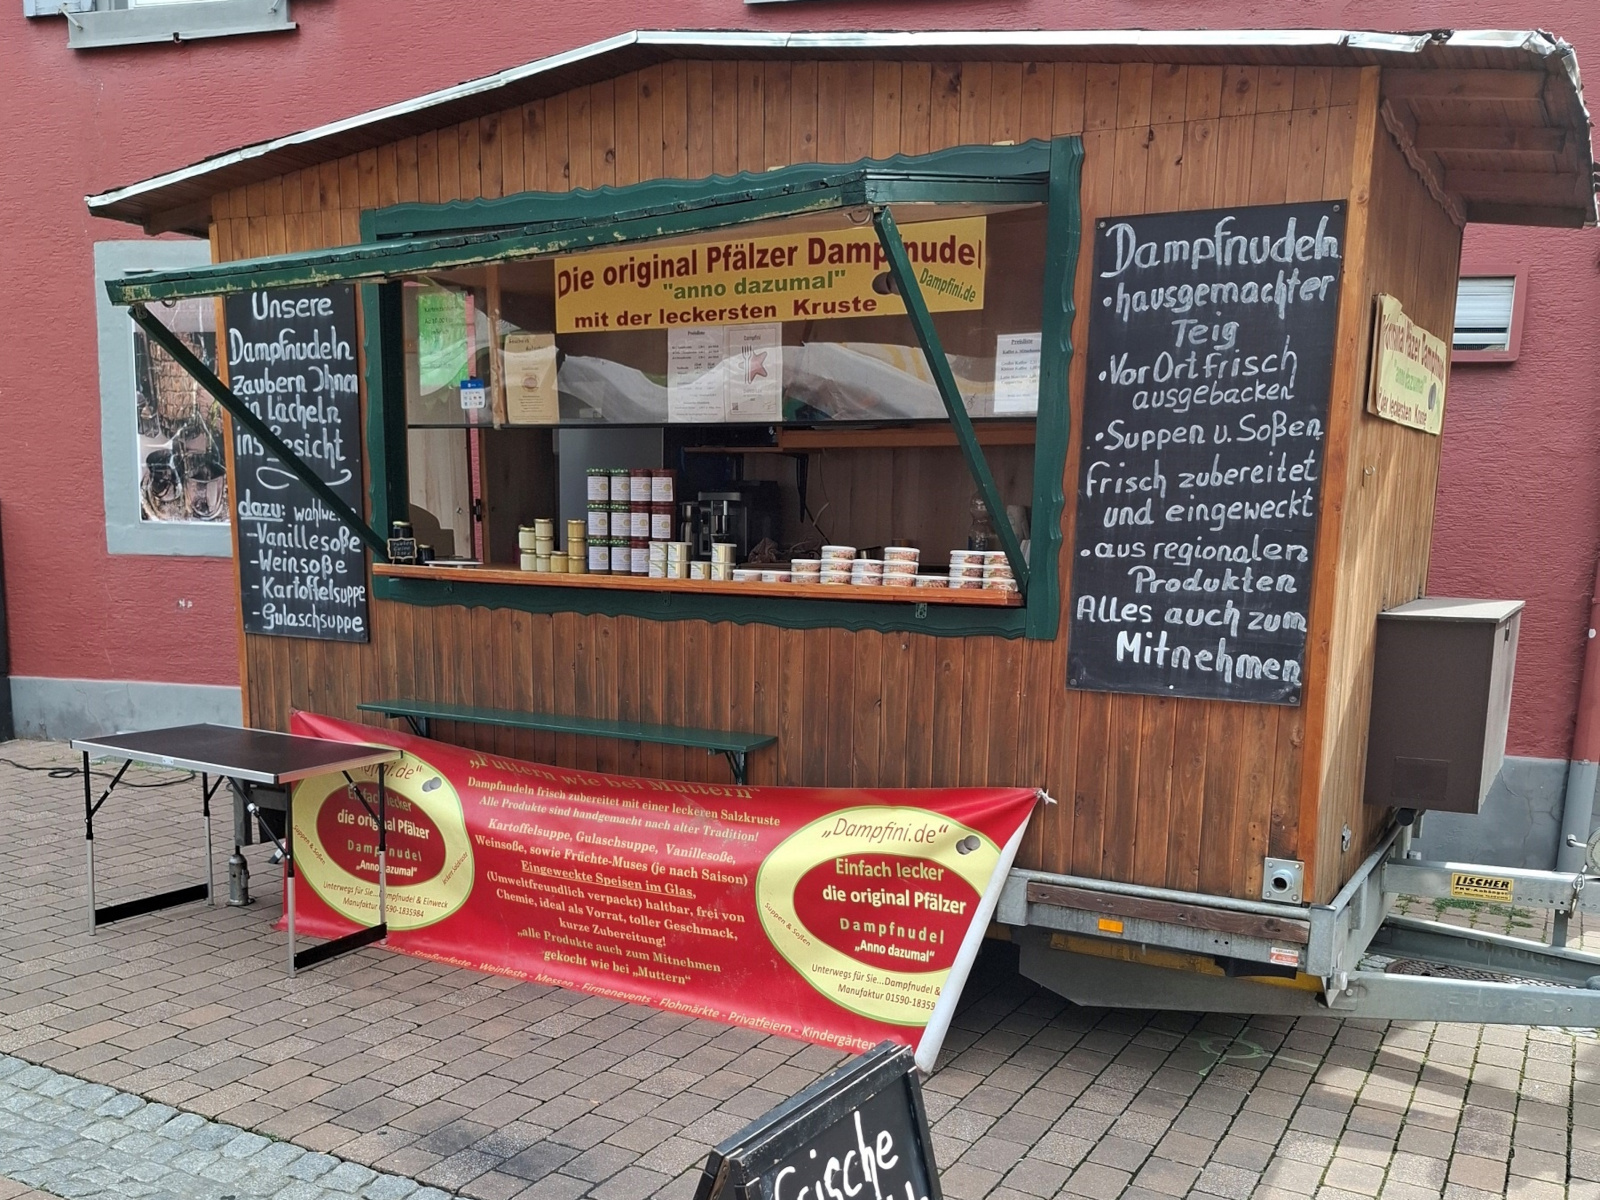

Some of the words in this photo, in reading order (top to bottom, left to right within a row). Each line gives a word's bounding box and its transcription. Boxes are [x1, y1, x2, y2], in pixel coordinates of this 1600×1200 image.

[1100, 215, 1342, 278] Dampfnudeln
[558, 266, 595, 299] Die
[603, 248, 698, 289] original
[707, 242, 799, 274] Pfälzer
[808, 234, 982, 271] Dampnudel
[919, 267, 976, 303] Dampfini.de
[1115, 268, 1336, 323] hausgemachter
[252, 291, 334, 320] Unsere
[575, 312, 609, 328] mit
[617, 310, 653, 326] der
[659, 303, 777, 325] leckersten
[793, 296, 877, 316] Kruste
[229, 325, 354, 366] Dampfnudeln
[1171, 311, 1240, 351] Teig
[1110, 352, 1150, 385] Vor
[1153, 350, 1198, 382] Ort
[1203, 335, 1297, 388] frisch
[268, 394, 342, 429] Lächeln
[1132, 379, 1295, 413] ausgebacken
[237, 425, 265, 456] ins
[1104, 419, 1206, 451] Suppen
[1236, 410, 1324, 446] Soßen
[1086, 459, 1167, 498] frisch
[1179, 449, 1318, 487] zubereitet
[238, 489, 287, 520] dazu:
[1103, 498, 1154, 528] und
[1165, 487, 1314, 531] eingeweckt
[1094, 541, 1147, 559] aus
[1153, 534, 1308, 566] regionalen
[1127, 565, 1297, 593] Produkten
[1077, 595, 1153, 622] Alles
[1165, 599, 1240, 637] auch
[1248, 611, 1307, 633] zum
[1116, 630, 1302, 686] Mitnehmen
[561, 774, 601, 787] wie
[602, 776, 644, 790] bei
[468, 776, 534, 795] Dampfnudeln
[537, 787, 566, 800] frisch
[568, 791, 619, 806] zubereitet
[622, 799, 639, 809] mit
[642, 801, 669, 812] einer
[672, 803, 718, 819] leckeren
[720, 809, 780, 826] Salzkruste
[479, 795, 499, 807] Alle
[501, 797, 546, 813] Produkte
[549, 805, 571, 817] sind
[573, 809, 642, 826] handgemacht
[645, 818, 670, 830] nach
[673, 822, 700, 835] alter
[703, 825, 759, 842] Tradition!
[337, 809, 355, 825] die
[398, 819, 430, 840] Pfälzer
[488, 818, 573, 842] Kartoffelsuppe,
[575, 830, 658, 854] Gulaschsuppe,
[666, 843, 736, 865] Vanillesoße,
[822, 817, 949, 844] „Dampfini.de“
[294, 824, 310, 845] Suppen
[313, 848, 326, 865] Soßen
[347, 839, 422, 861] Dampnudel
[475, 834, 527, 854] Weinsoße,
[530, 844, 560, 858] sowie
[564, 848, 648, 872] Früchte-Muses
[651, 862, 666, 875] (je
[669, 865, 698, 879] nach
[701, 868, 748, 886] Saison)
[385, 865, 418, 877] azumal“
[521, 860, 593, 882] Eingeweckte
[595, 872, 642, 889] Speisen
[645, 880, 662, 892] im
[664, 883, 697, 899] Glas,
[836, 857, 892, 878] Einfach
[897, 862, 944, 882] lecker
[1456, 876, 1510, 888] LISCHER
[323, 881, 354, 894] Unterwegs
[354, 886, 365, 896] für
[416, 896, 422, 904] &
[423, 897, 449, 908] Einweck
[342, 897, 378, 911] Manufaktur
[487, 870, 585, 898] (Umweltfreundlich
[587, 891, 643, 909] verpackt)
[645, 899, 693, 916] haltbar,
[696, 906, 718, 919] frei
[722, 913, 745, 923] von
[822, 885, 847, 902] die
[850, 888, 910, 907] original
[914, 892, 967, 915] Pfälzer
[496, 888, 538, 907] Chemie,
[540, 897, 565, 911] ideal
[568, 903, 584, 915] als
[585, 906, 627, 924] Vorrat,
[629, 914, 661, 928] toller
[664, 919, 738, 941] Geschmack,
[559, 917, 590, 932] kurze
[592, 924, 666, 947] Zubereitung!
[764, 902, 786, 925] Suppen
[786, 922, 792, 930] &
[792, 928, 811, 947] Soßen
[839, 917, 944, 945] Dampfnudel
[517, 927, 541, 938] „alle
[544, 930, 593, 949] Produkte
[596, 942, 622, 955] auch
[625, 949, 650, 960] zum
[653, 952, 721, 972] Mitnehmen
[544, 950, 587, 966] gekocht
[590, 960, 609, 970] wie
[612, 960, 629, 973] bei
[632, 966, 691, 984] „Muttern“
[854, 939, 886, 955] „Anno
[888, 944, 935, 962] dazumal“
[411, 950, 472, 966] Straßenfeste
[479, 962, 528, 978] Weinfeste
[535, 973, 574, 988] Messen
[581, 983, 651, 1003] Firmenevents
[658, 998, 720, 1018] Flohmärkte
[727, 1011, 792, 1034] Privatfeiern
[811, 963, 852, 979] Unterwegs
[852, 971, 865, 982] für
[934, 987, 941, 996] &
[837, 984, 884, 1001] Manufaktur
